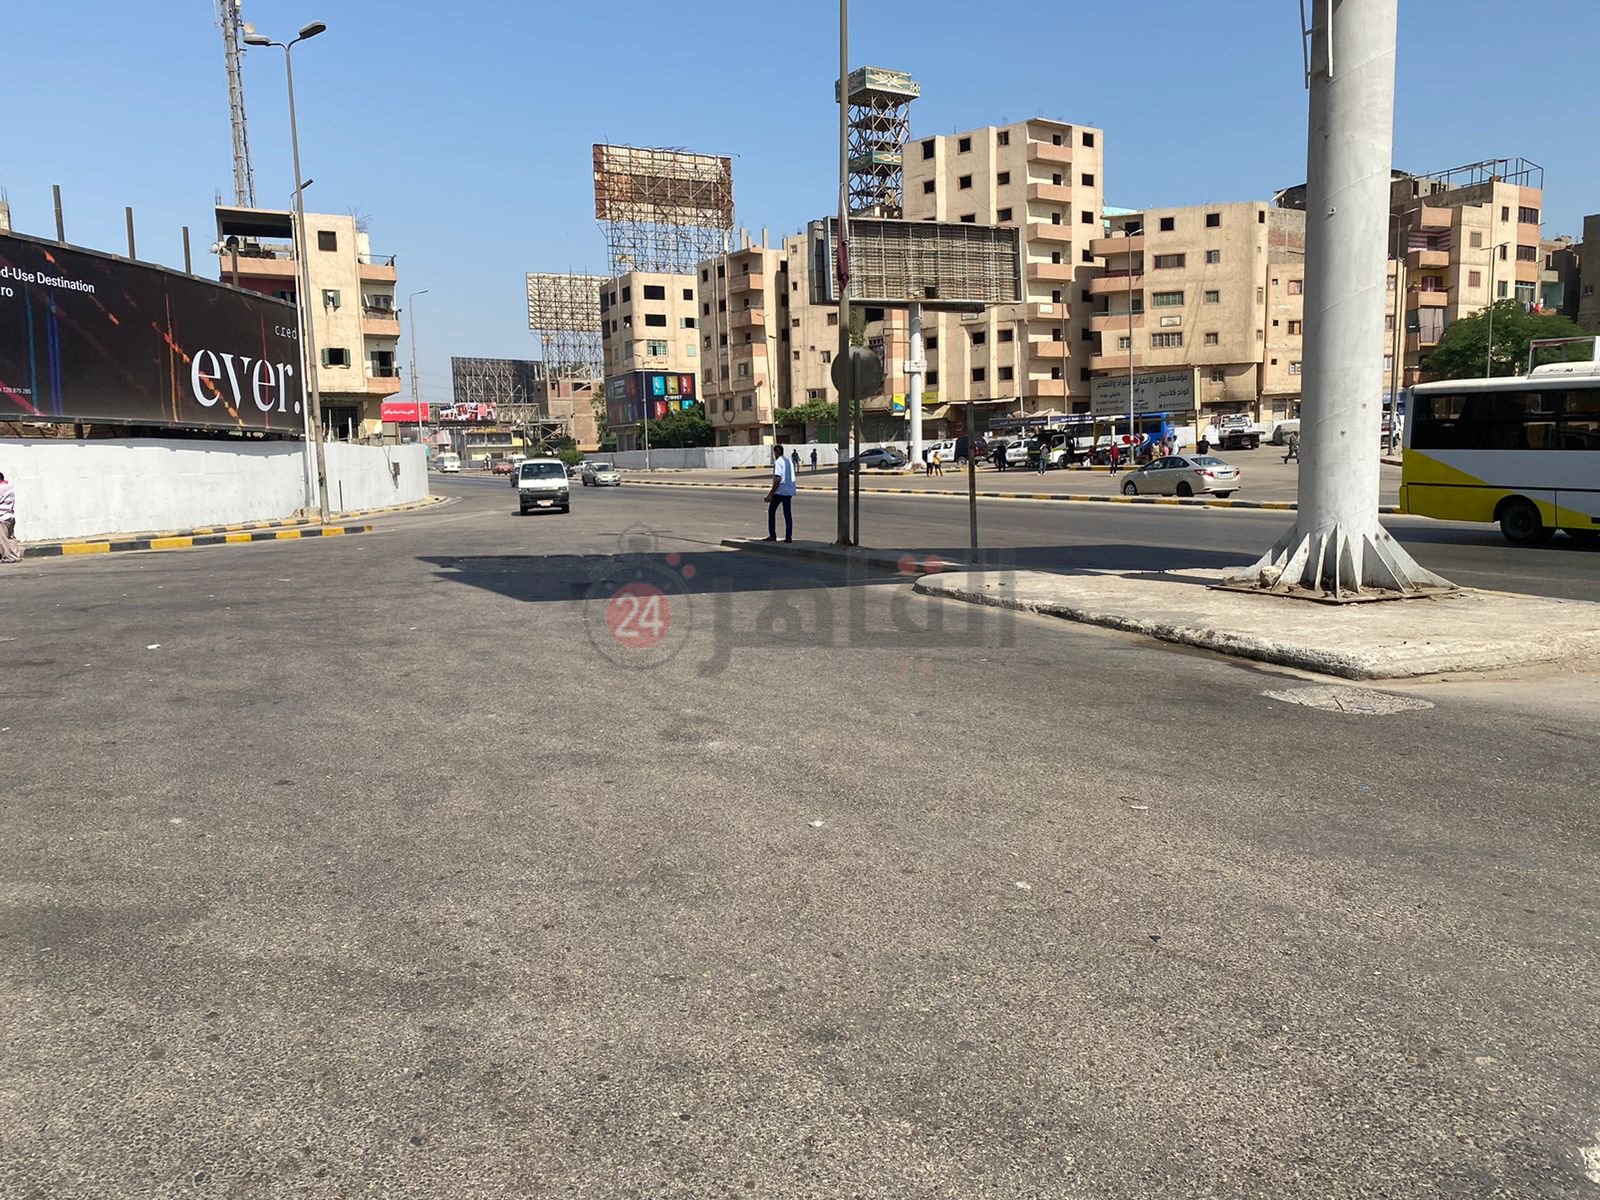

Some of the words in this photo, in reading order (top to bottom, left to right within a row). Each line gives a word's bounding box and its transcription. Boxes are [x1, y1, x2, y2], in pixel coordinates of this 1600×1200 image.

[0, 265, 35, 283] d-Use
[36, 271, 95, 294] Destination
[274, 325, 297, 340] cred
[191, 349, 300, 415] ever.
